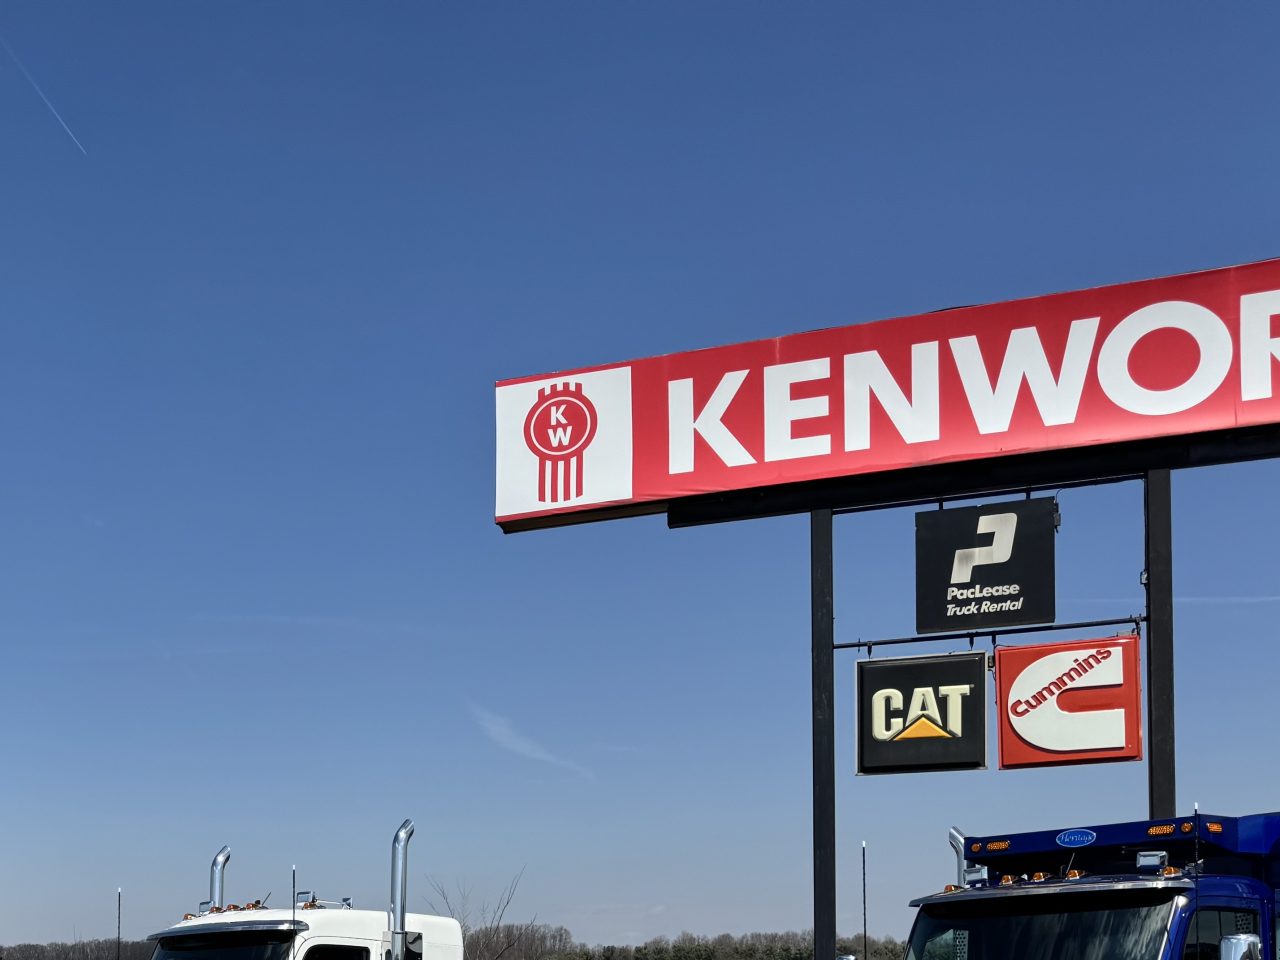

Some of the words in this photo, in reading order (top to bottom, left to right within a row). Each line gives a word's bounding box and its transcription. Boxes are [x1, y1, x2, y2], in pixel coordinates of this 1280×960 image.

[550, 404, 568, 425] K
[547, 425, 573, 447] W
[947, 583, 1020, 601] PacLease
[946, 602, 980, 616] Truck
[980, 597, 1024, 613] Rental
[1010, 648, 1112, 717] Cummins
[872, 684, 971, 741] CAT
